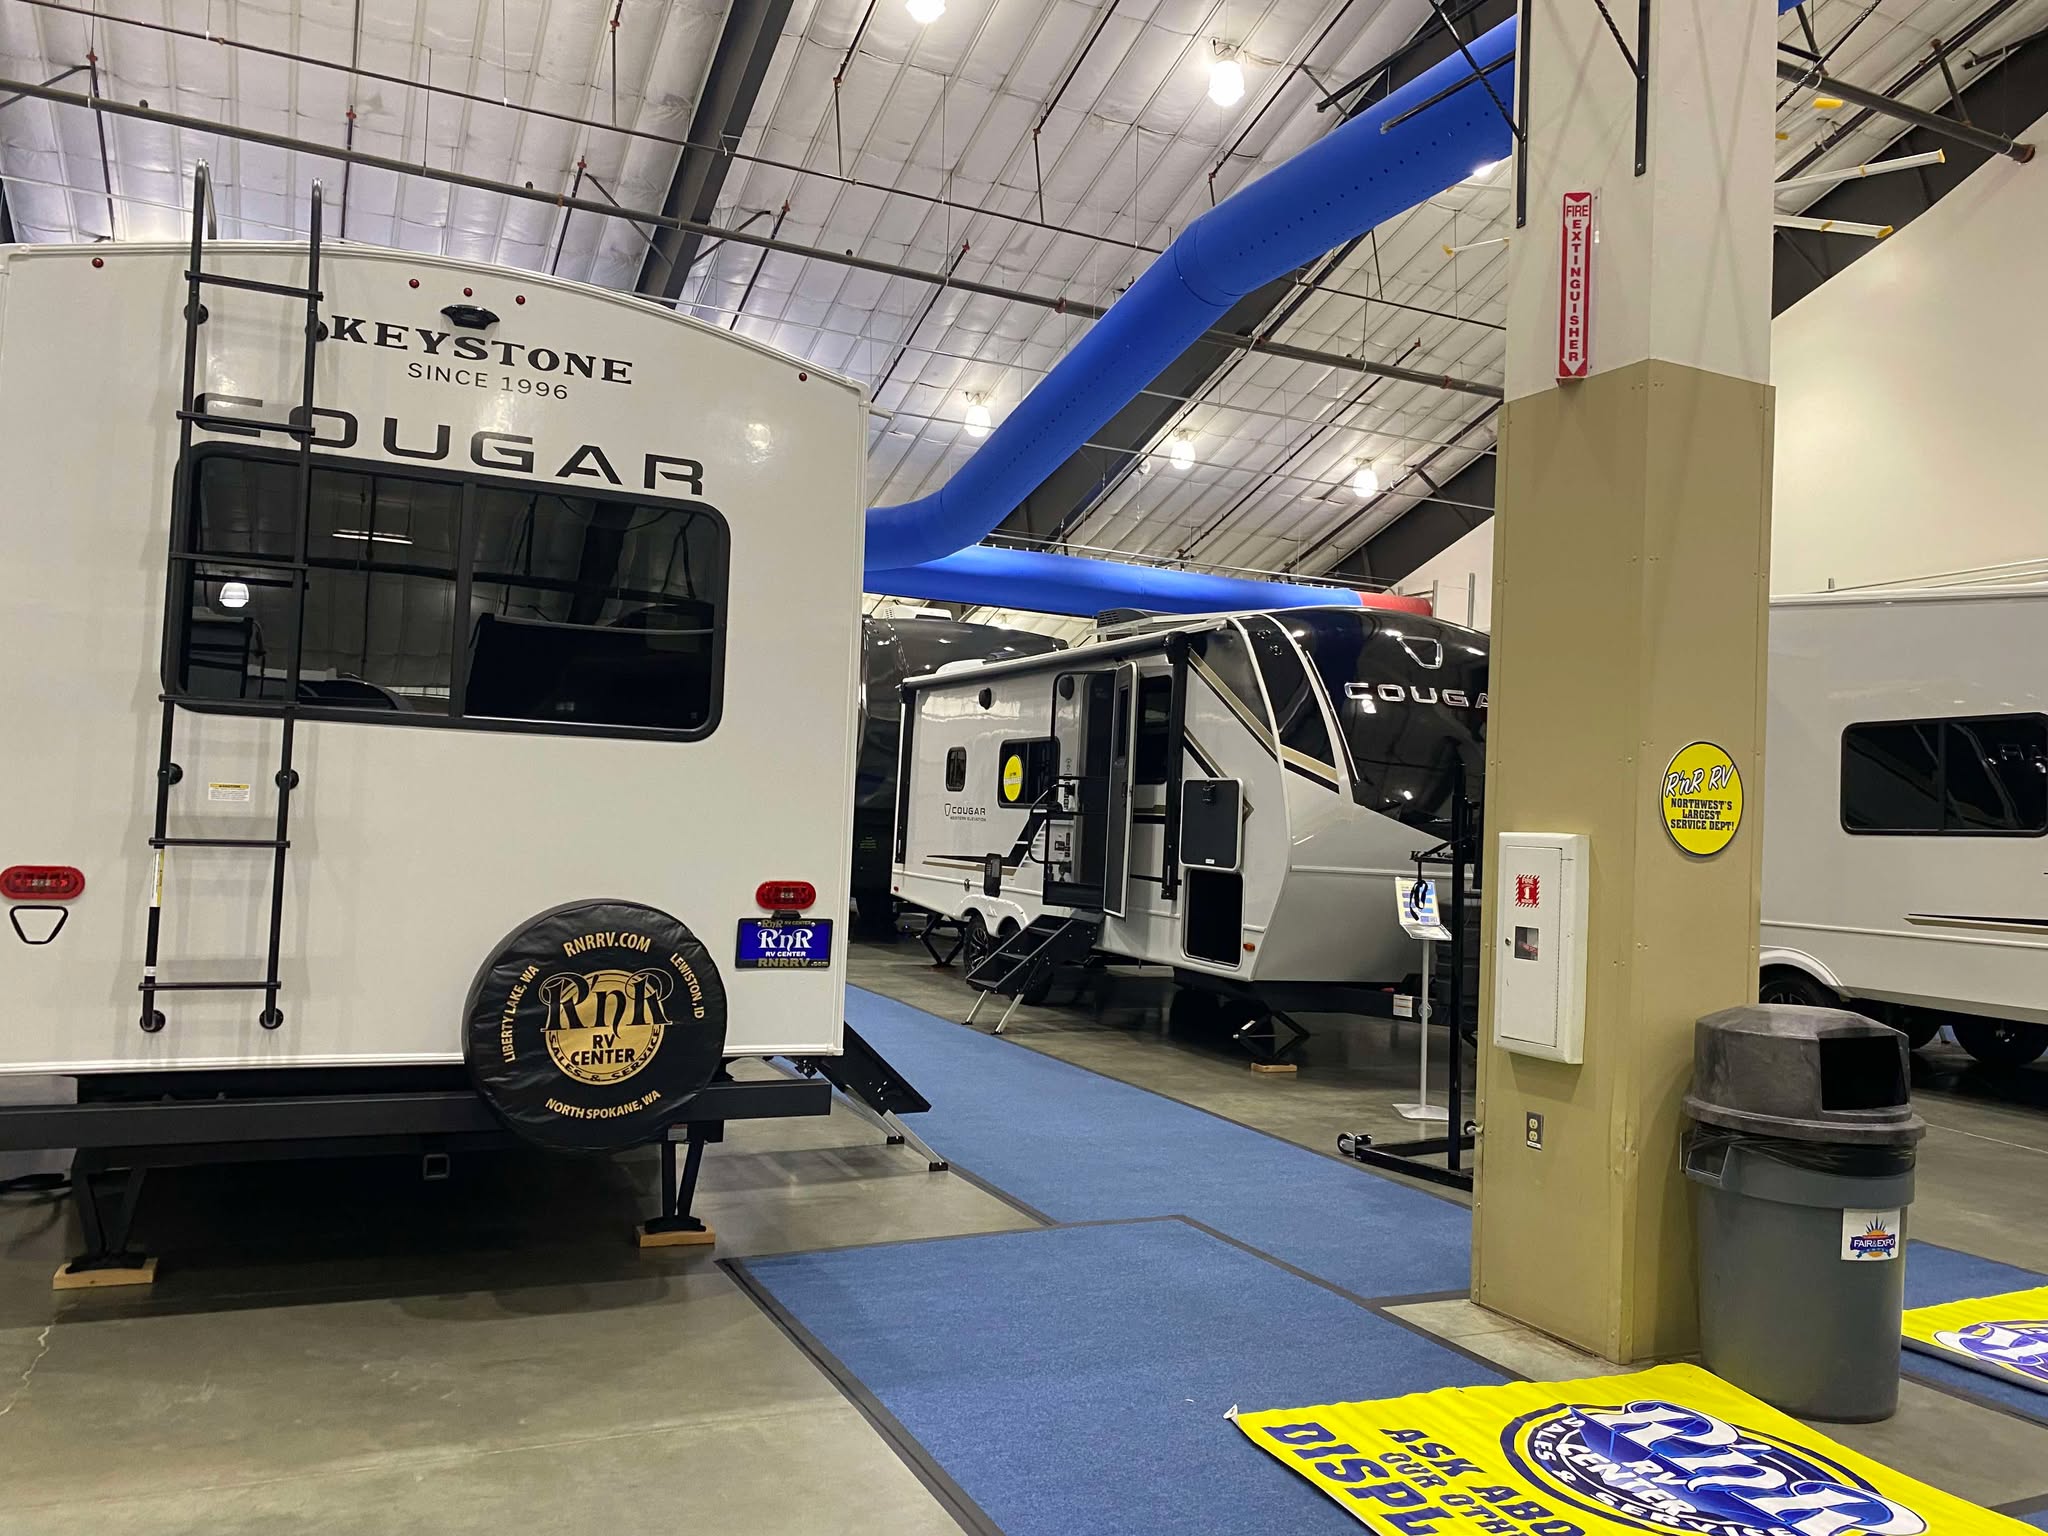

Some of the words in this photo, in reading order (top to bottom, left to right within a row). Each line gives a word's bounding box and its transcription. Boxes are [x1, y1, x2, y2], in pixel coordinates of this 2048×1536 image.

[1566, 204, 1589, 217] FIRE
[1568, 219, 1582, 362] EXTINGUISHER
[329, 314, 633, 385] KEYSTONE
[407, 362, 489, 388] SINCE
[500, 376, 569, 400] 1996
[193, 392, 704, 496] COUGAR
[1665, 767, 1706, 798] R'nR
[1708, 764, 1735, 791] RV
[951, 806, 986, 816] COUGAR
[1671, 798, 1732, 810] NORTHWEST'S
[1682, 809, 1722, 820] LARGEST
[1670, 819, 1707, 830] SERVICE
[1709, 821, 1735, 831] DEPT!
[563, 931, 652, 957] RNRRV.COM
[757, 929, 813, 951] R'nR
[519, 965, 540, 984] WA
[504, 984, 528, 1014] LAKE,
[693, 1006, 705, 1019] ID
[500, 1016, 516, 1064] LIBERTY
[592, 1033, 616, 1050] RV
[549, 1033, 582, 1078] SALES
[590, 1073, 601, 1082] &
[611, 1027, 661, 1080] SERVICE
[570, 1048, 636, 1066] CENTER
[545, 1098, 585, 1119] NORTH
[586, 1100, 643, 1120] SPOKANE,
[641, 1089, 662, 1106] WA
[1877, 1239, 1894, 1247] EXPO
[1534, 1416, 1586, 1462] SALES
[1261, 1421, 1455, 1536] DISPL
[1379, 1428, 1488, 1477] ASK
[1465, 1485, 1586, 1536] ABO
[1550, 1469, 1577, 1484] &
[1555, 1442, 1698, 1507] CENTER
[1640, 1459, 1689, 1486] RV
[1379, 1452, 1448, 1489] OUR
[1439, 1493, 1530, 1536] OTH
